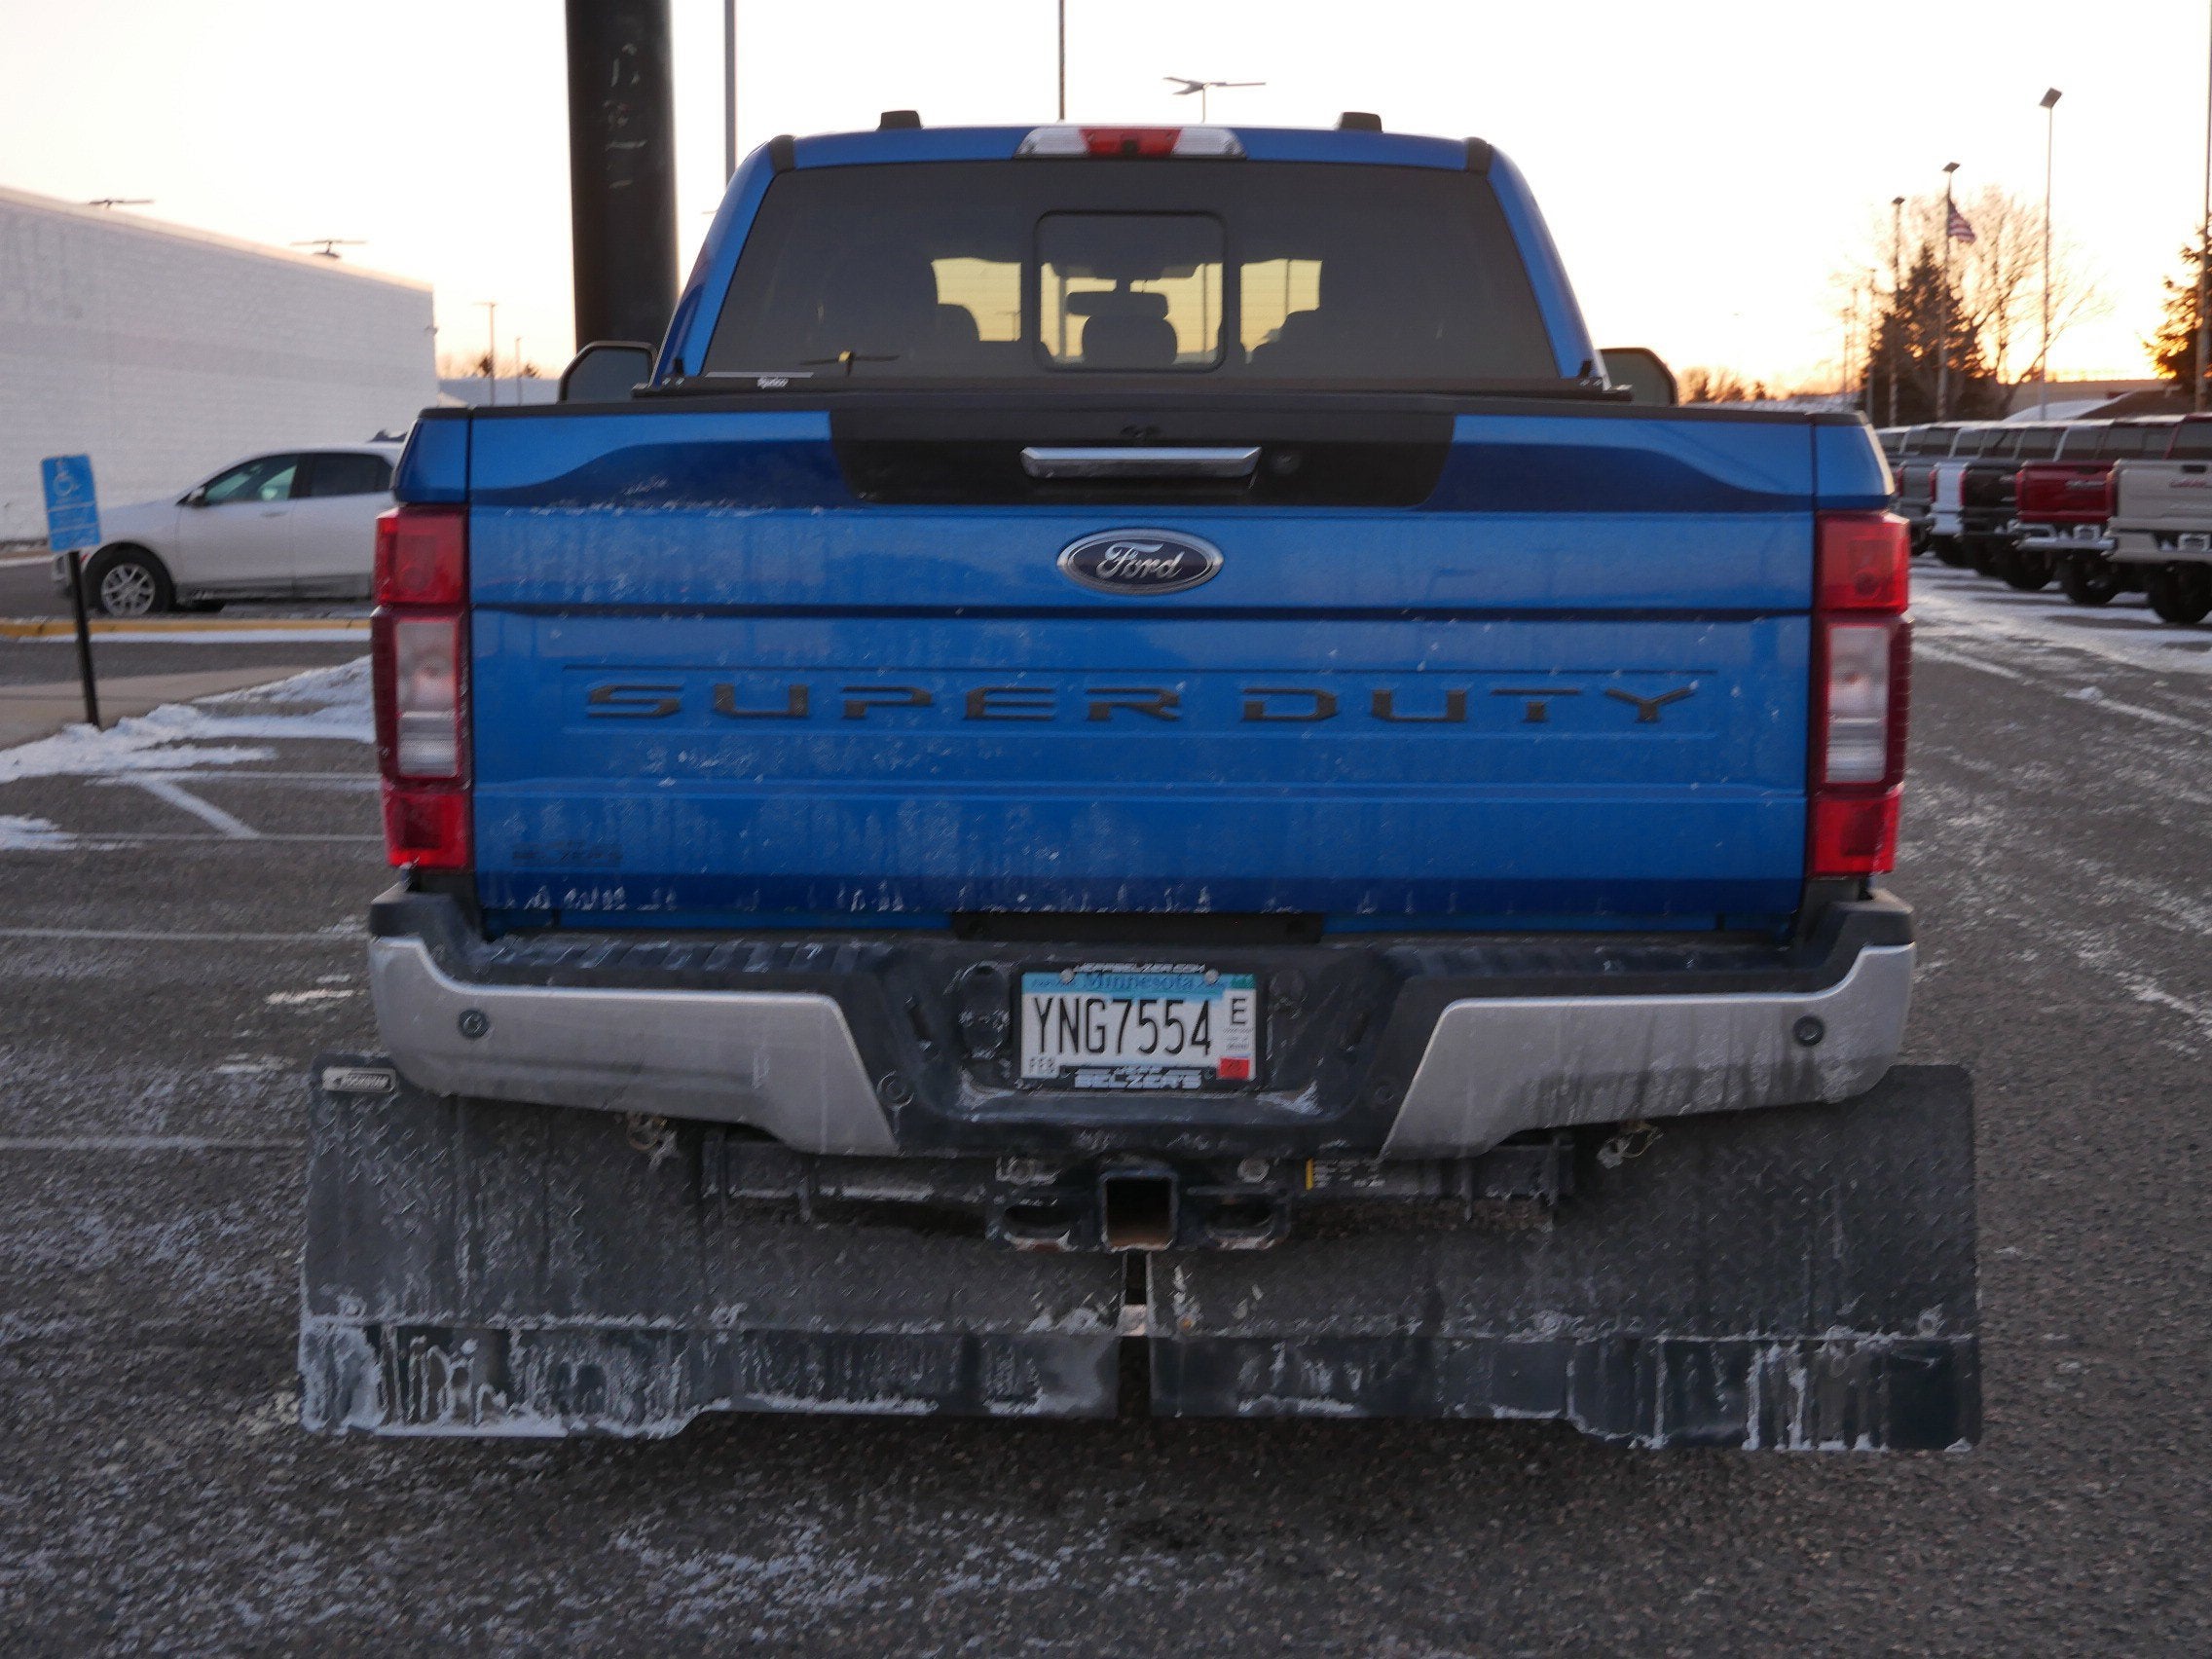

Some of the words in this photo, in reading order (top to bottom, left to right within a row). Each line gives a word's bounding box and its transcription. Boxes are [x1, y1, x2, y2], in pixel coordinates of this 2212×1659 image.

[1096, 541, 1185, 578] Ford
[586, 684, 1180, 722] SUPER
[1241, 686, 1697, 723] DUTY
[1086, 972, 1194, 990] Minnesota
[1034, 997, 1211, 1055] YNG7554
[1231, 997, 1246, 1024] E
